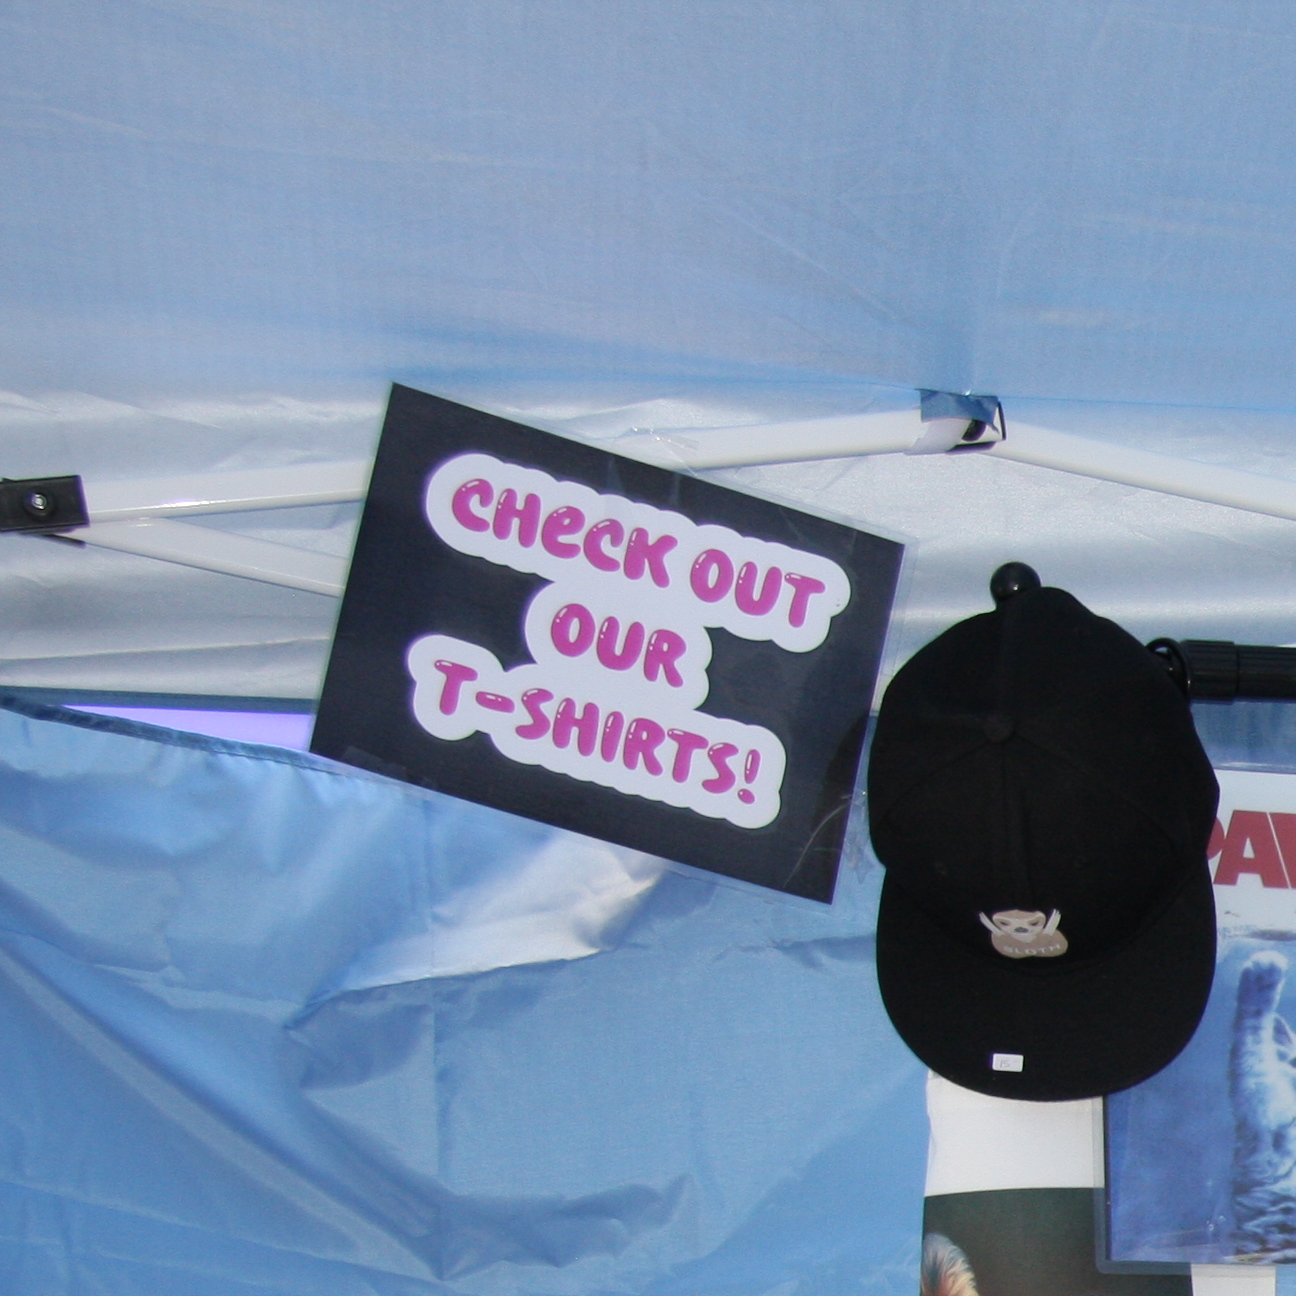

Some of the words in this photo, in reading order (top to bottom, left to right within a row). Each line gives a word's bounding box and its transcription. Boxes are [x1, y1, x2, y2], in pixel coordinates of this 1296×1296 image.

[690, 548, 825, 628] OUT
[550, 602, 686, 688] OUR
[434, 659, 761, 805] T-SHIRTS!
